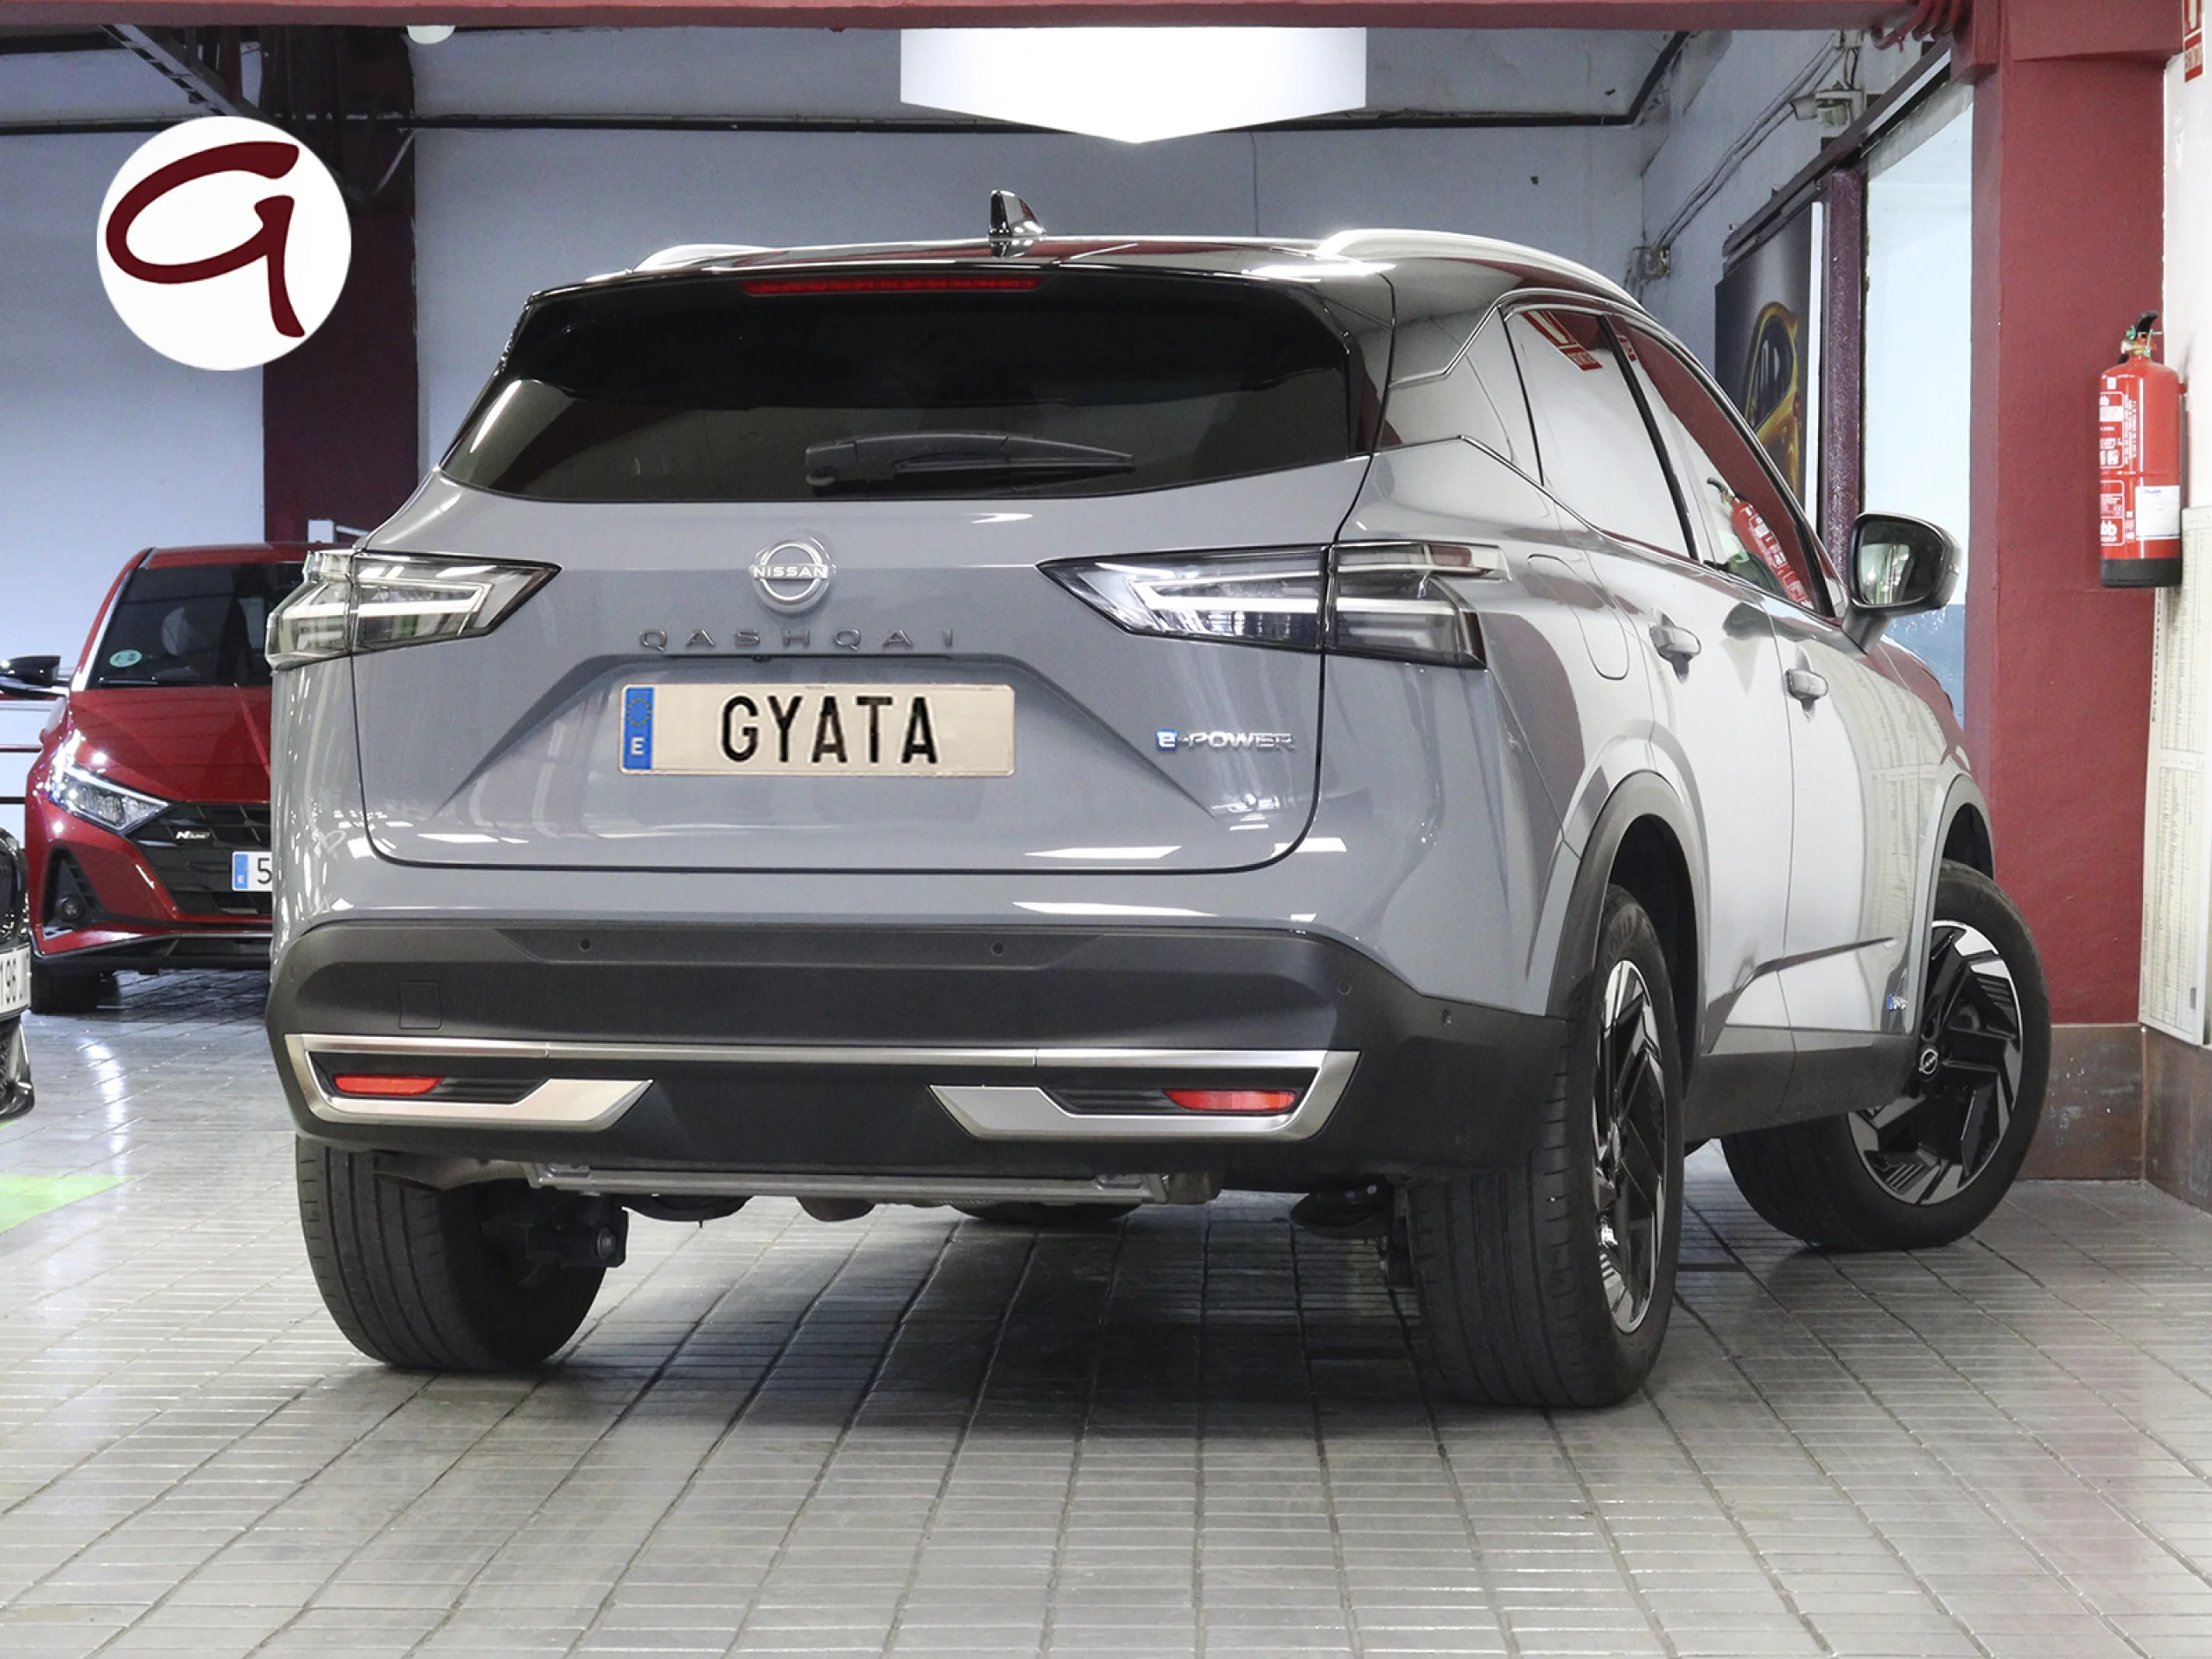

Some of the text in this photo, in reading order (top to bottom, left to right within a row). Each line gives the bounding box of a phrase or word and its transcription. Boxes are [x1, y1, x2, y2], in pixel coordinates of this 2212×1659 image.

[753, 566, 828, 578] NISSAN
[639, 629, 954, 651] QASHQAI
[632, 695, 938, 764] E GYATA
